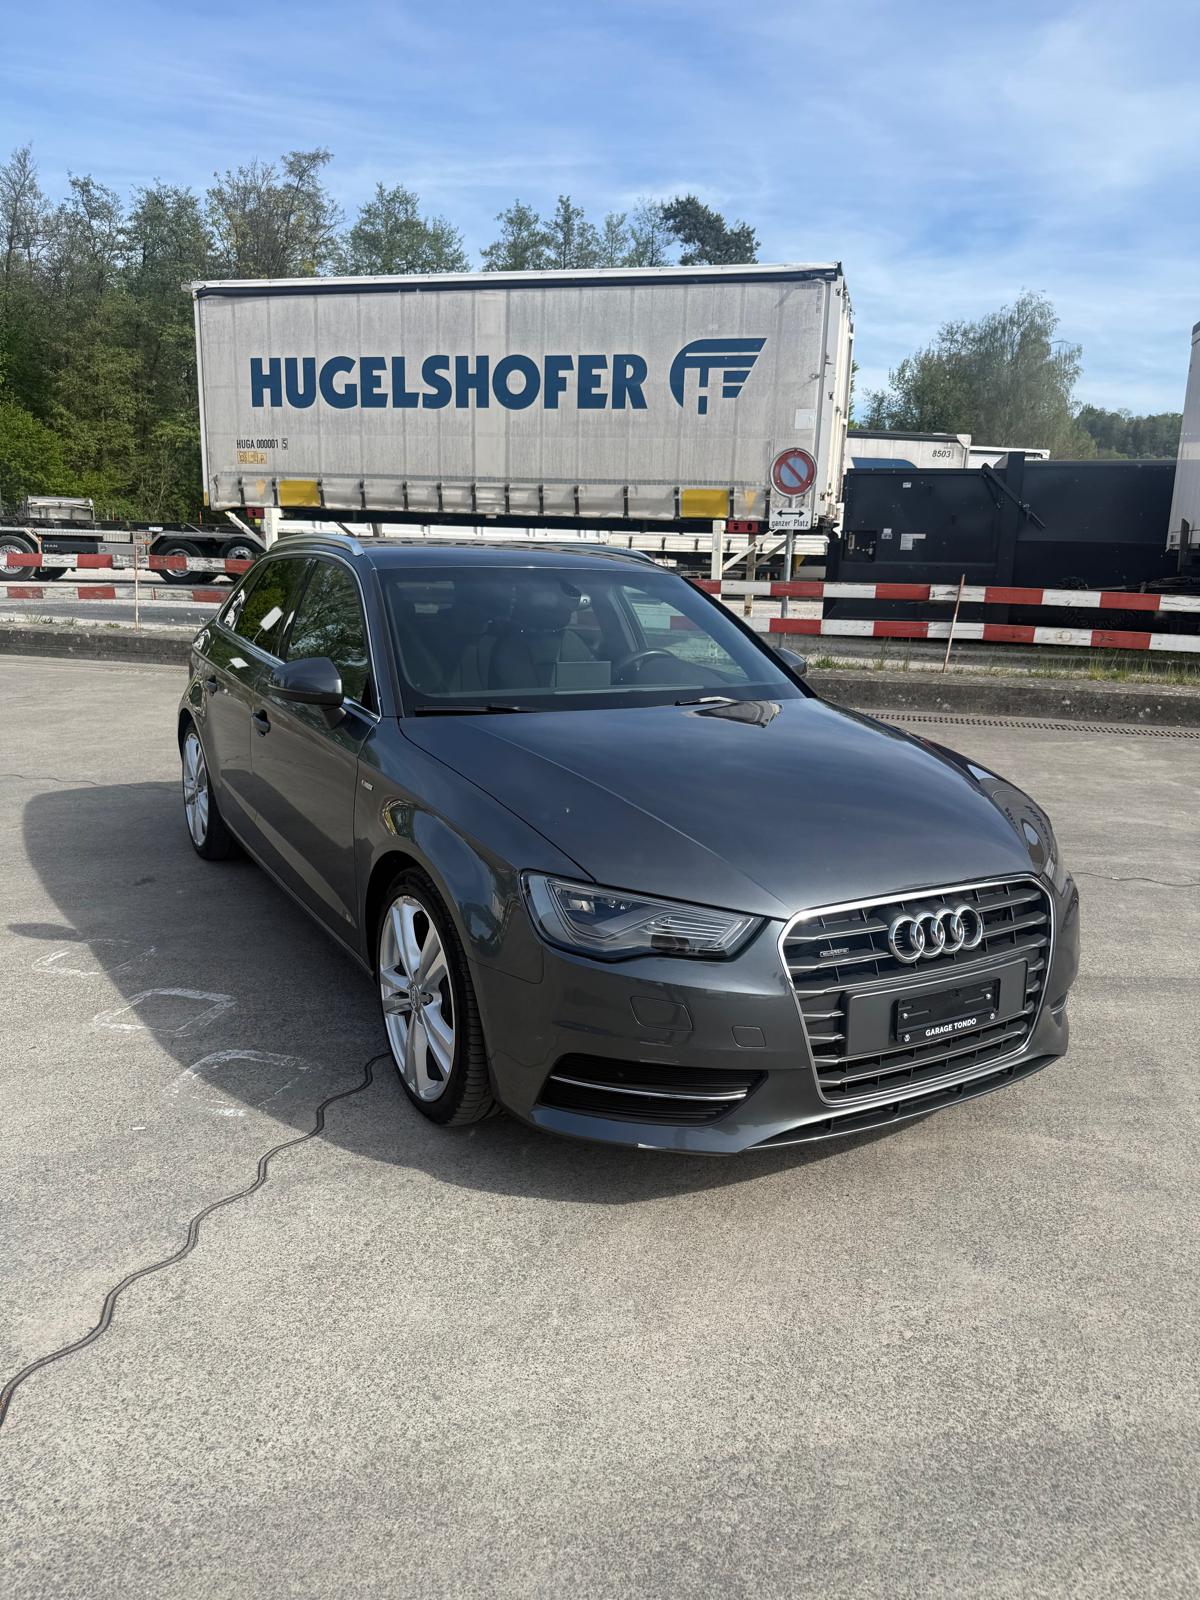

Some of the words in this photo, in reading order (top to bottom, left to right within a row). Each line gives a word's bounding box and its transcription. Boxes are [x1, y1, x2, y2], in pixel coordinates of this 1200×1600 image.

[250, 354, 648, 410] HUGELSHOFER
[236, 439, 255, 449] HUGA
[256, 439, 278, 449] 000001
[932, 449, 951, 458] 8503
[771, 520, 791, 528] ganzer
[793, 519, 809, 527] Platz
[925, 1023, 953, 1036] GARAGE
[953, 1017, 977, 1029] TONDO
